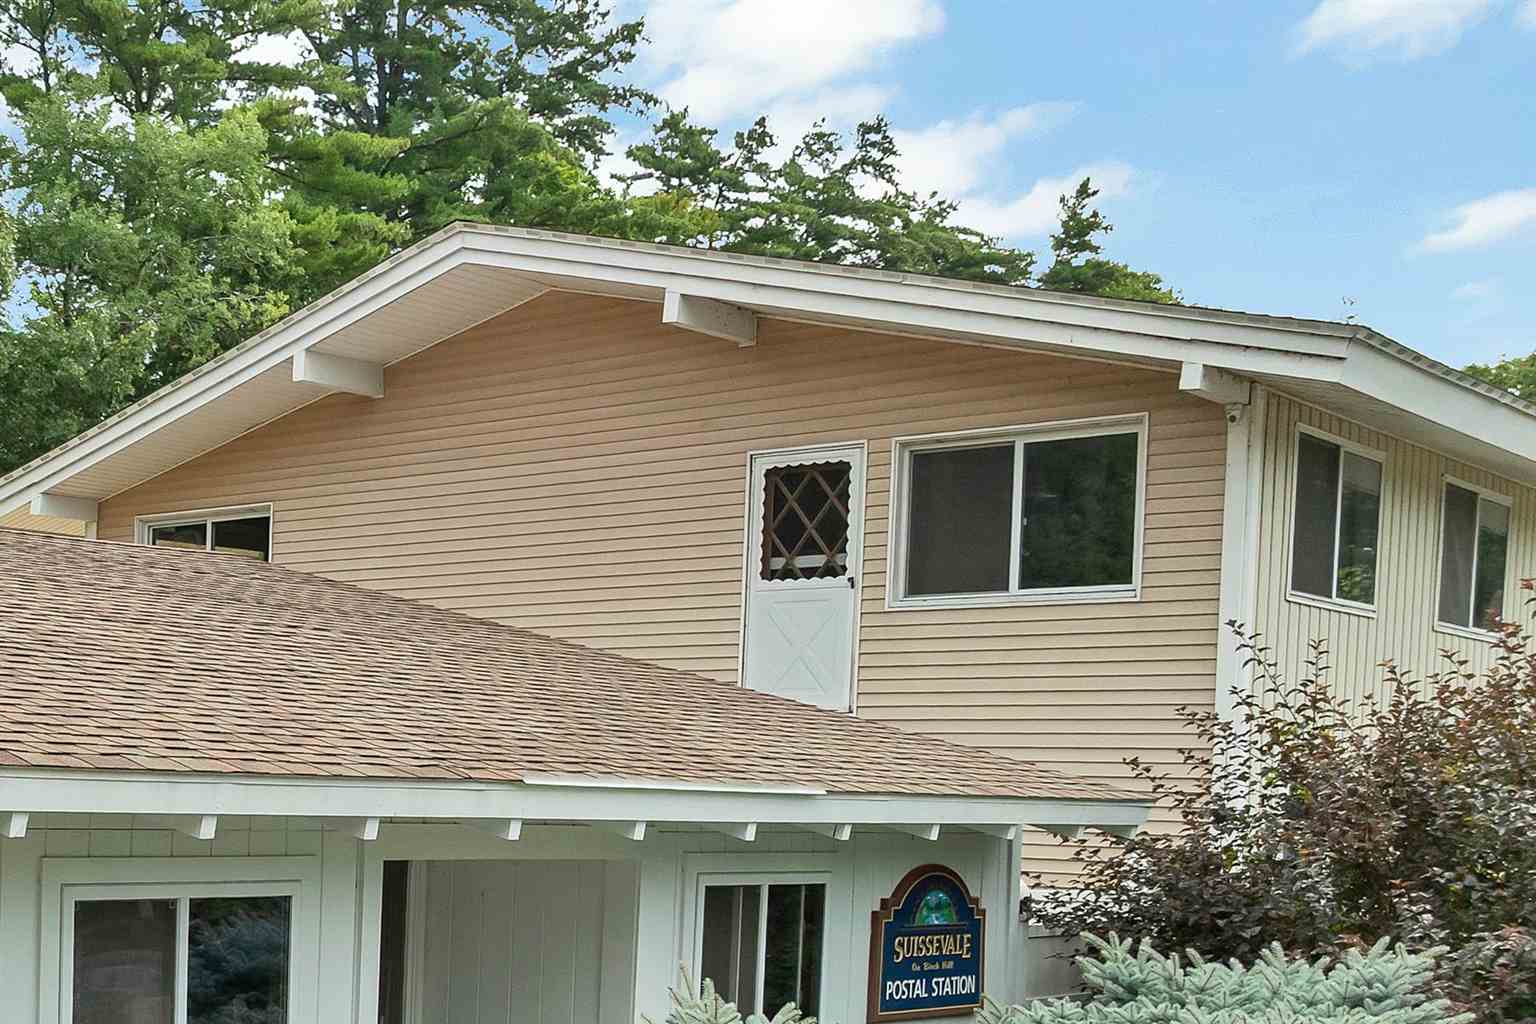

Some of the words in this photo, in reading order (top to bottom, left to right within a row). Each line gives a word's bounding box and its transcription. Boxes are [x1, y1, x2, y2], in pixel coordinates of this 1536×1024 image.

[894, 933, 971, 963] SUISSEVALE
[886, 978, 928, 1000] POSTAL
[931, 975, 975, 996] STATION
